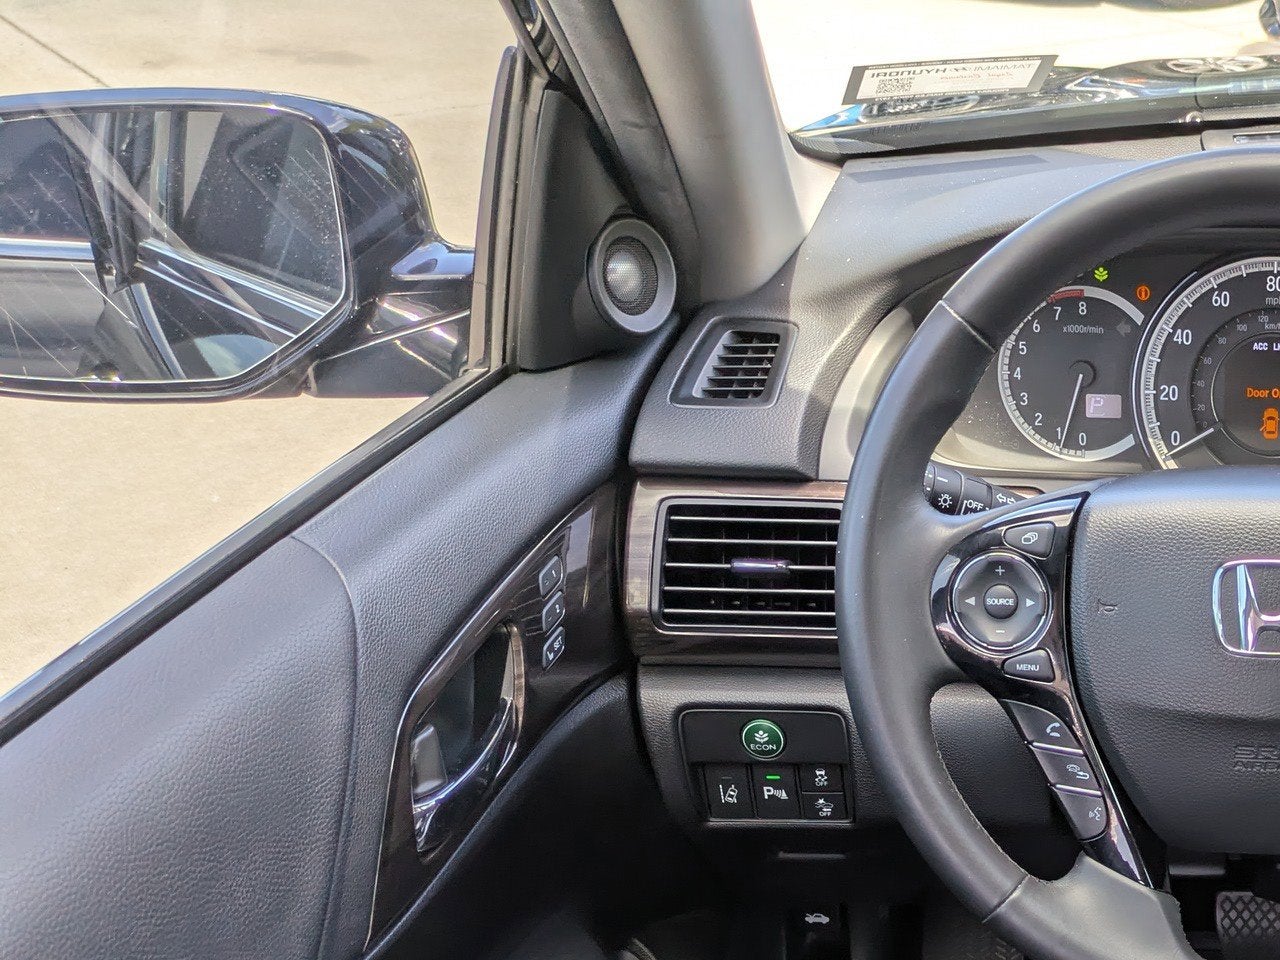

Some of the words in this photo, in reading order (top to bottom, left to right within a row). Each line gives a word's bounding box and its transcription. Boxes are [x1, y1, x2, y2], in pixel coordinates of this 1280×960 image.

[1212, 292, 1230, 307] 60
[1054, 307, 1062, 320] 7
[1079, 303, 1087, 314] 8
[1033, 320, 1040, 332] 6
[1063, 325, 1104, 334] x1000r/min
[1174, 330, 1192, 345] 40
[1020, 342, 1027, 354] 5
[1253, 342, 1268, 351] ACC
[1014, 368, 1021, 380] 4
[1020, 393, 1028, 405] 3
[1160, 385, 1178, 401] 20
[1247, 388, 1269, 398] Door
[1035, 413, 1042, 426] 2
[1057, 427, 1061, 439] 1
[1171, 431, 1180, 446] 0
[1079, 434, 1086, 445] 0
[967, 500, 984, 511] OFF
[986, 597, 1014, 606] SOURCE
[1016, 663, 1039, 672] MENU
[763, 786, 774, 799] P
